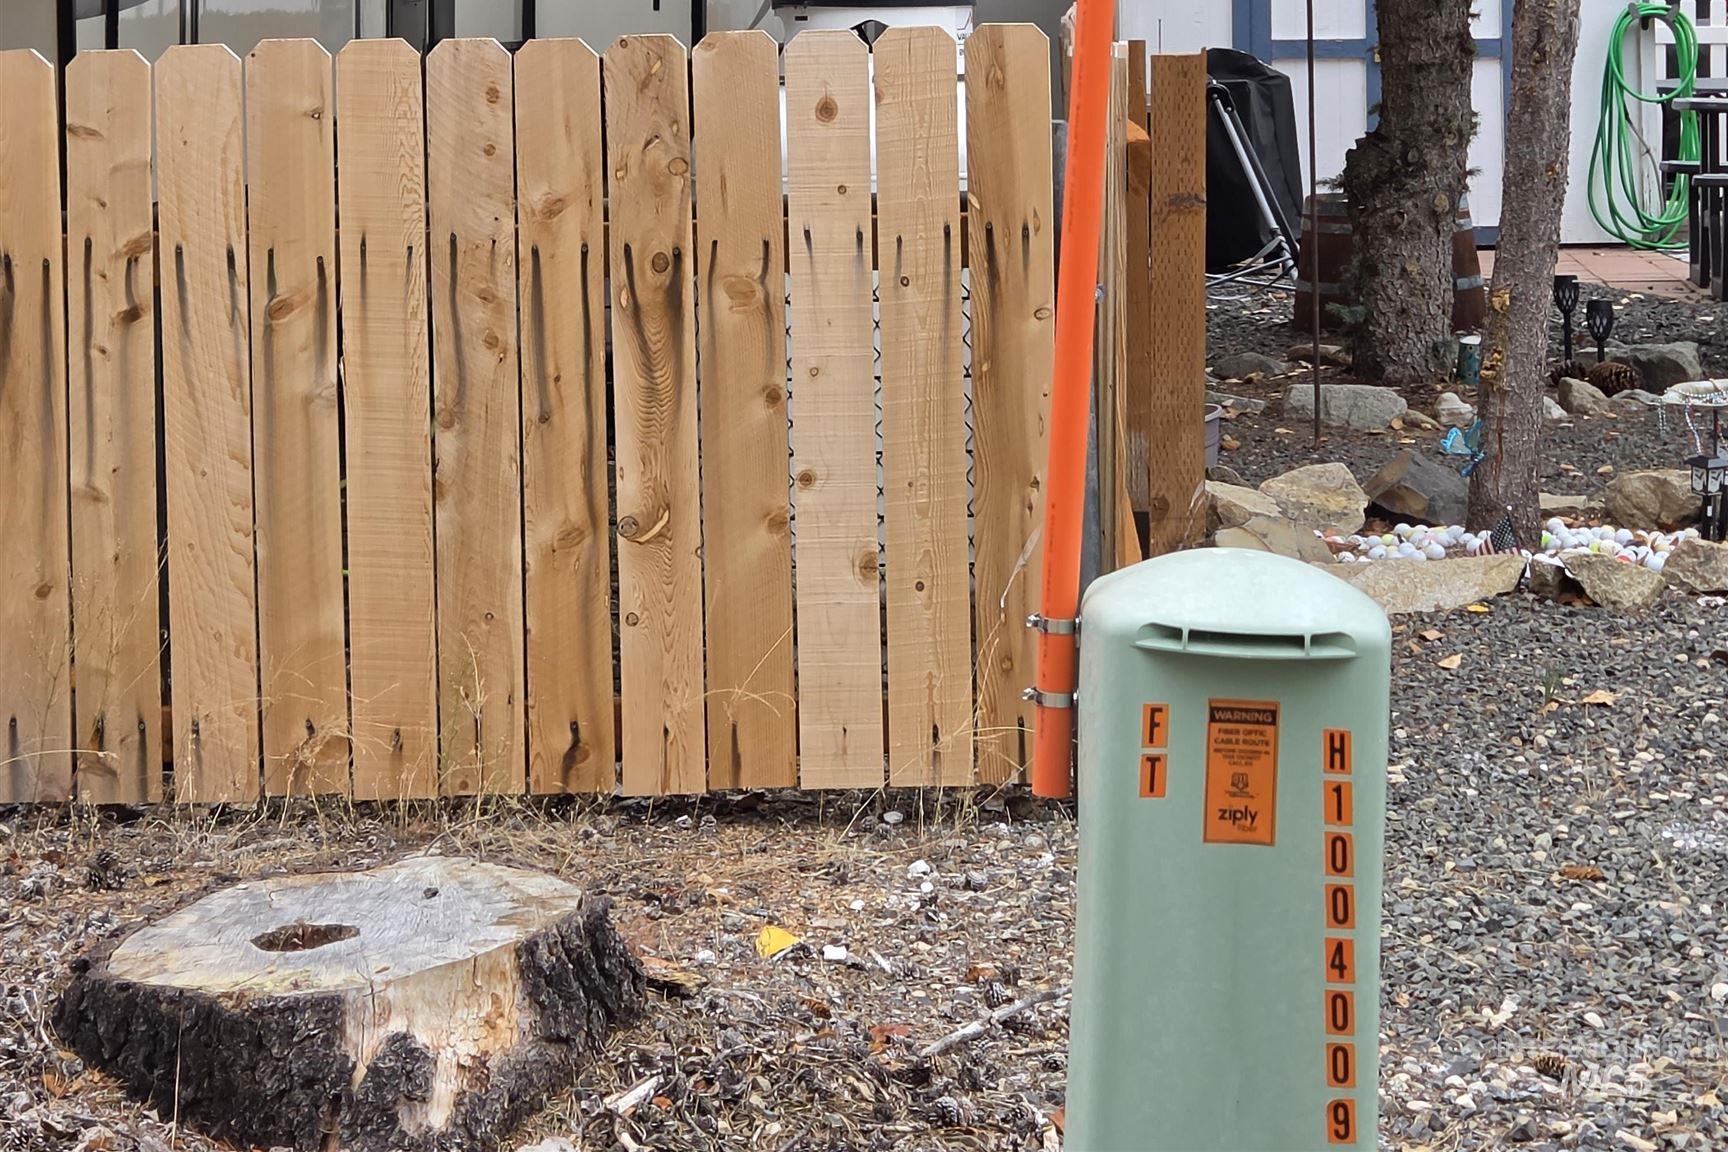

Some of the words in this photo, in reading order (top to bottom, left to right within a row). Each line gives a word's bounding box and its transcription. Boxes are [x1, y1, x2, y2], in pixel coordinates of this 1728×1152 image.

[1213, 709, 1273, 723] WARNING
[1217, 727, 1240, 736] FIBER
[1214, 737, 1241, 746] CABLE
[1242, 738, 1271, 748] ROUTE
[1218, 805, 1258, 826] ziply
